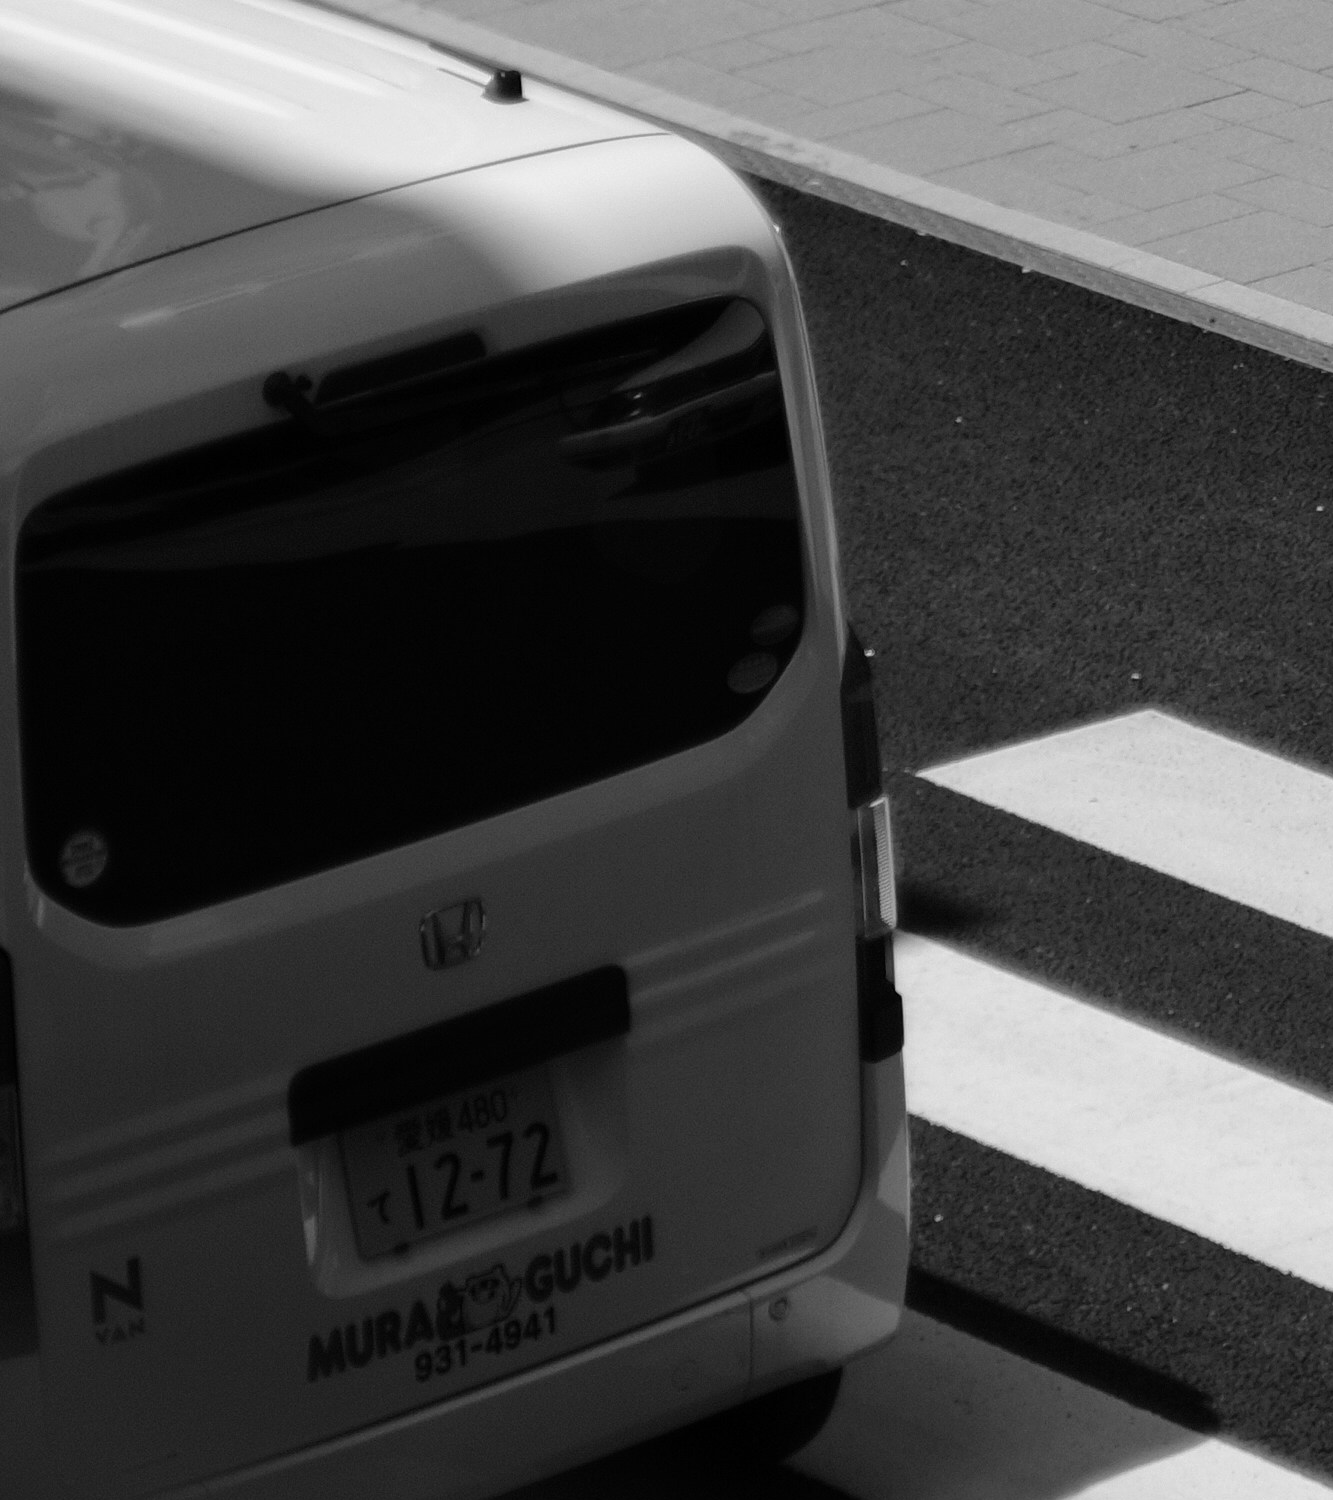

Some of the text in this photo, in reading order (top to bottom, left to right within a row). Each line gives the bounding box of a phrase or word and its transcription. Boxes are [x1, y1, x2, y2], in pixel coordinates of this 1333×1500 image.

[458, 1089, 509, 1133] 480
[366, 1121, 559, 1230] て 12-72
[89, 1255, 145, 1325] N
[525, 1215, 655, 1302] GUCHI
[414, 1306, 557, 1383] 931-4941
